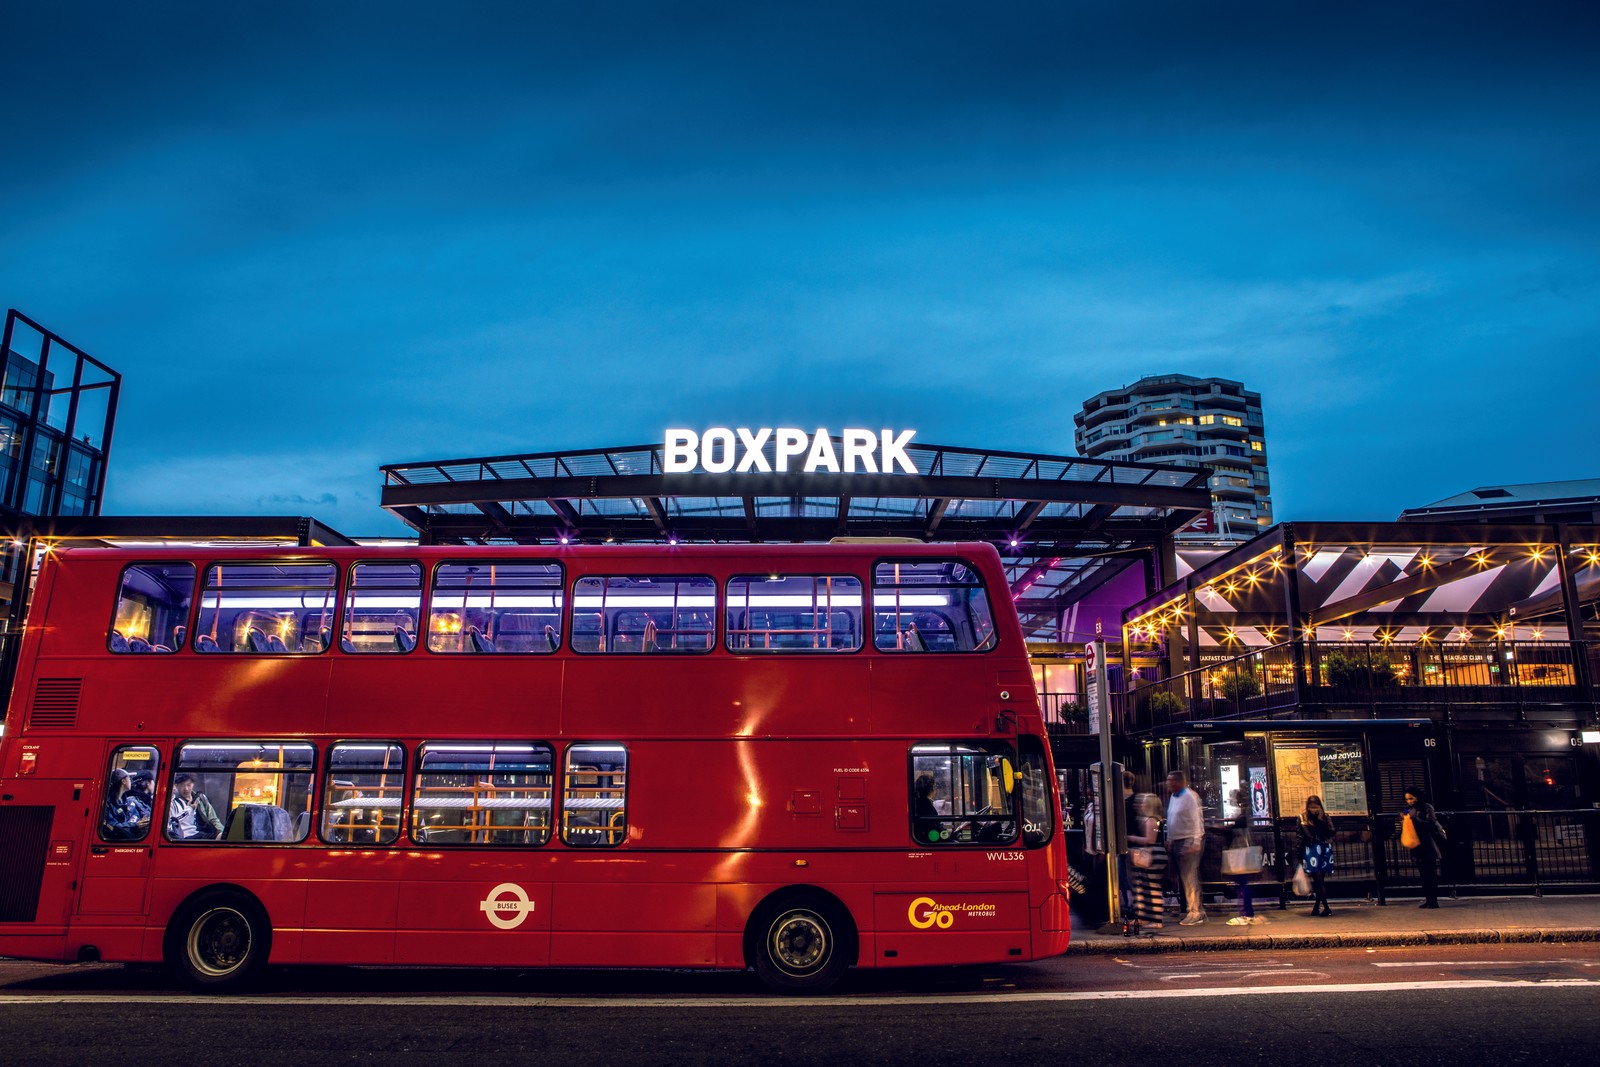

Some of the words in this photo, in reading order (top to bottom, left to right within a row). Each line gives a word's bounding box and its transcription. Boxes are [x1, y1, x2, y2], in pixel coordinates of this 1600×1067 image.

[664, 428, 919, 473] BOXPARK
[1424, 738, 1436, 747] 06
[1570, 737, 1583, 747] 05
[986, 852, 1024, 861] WVL336
[497, 902, 517, 910] BUSES
[908, 896, 954, 929] Go
[933, 902, 996, 911] Ahead-London
